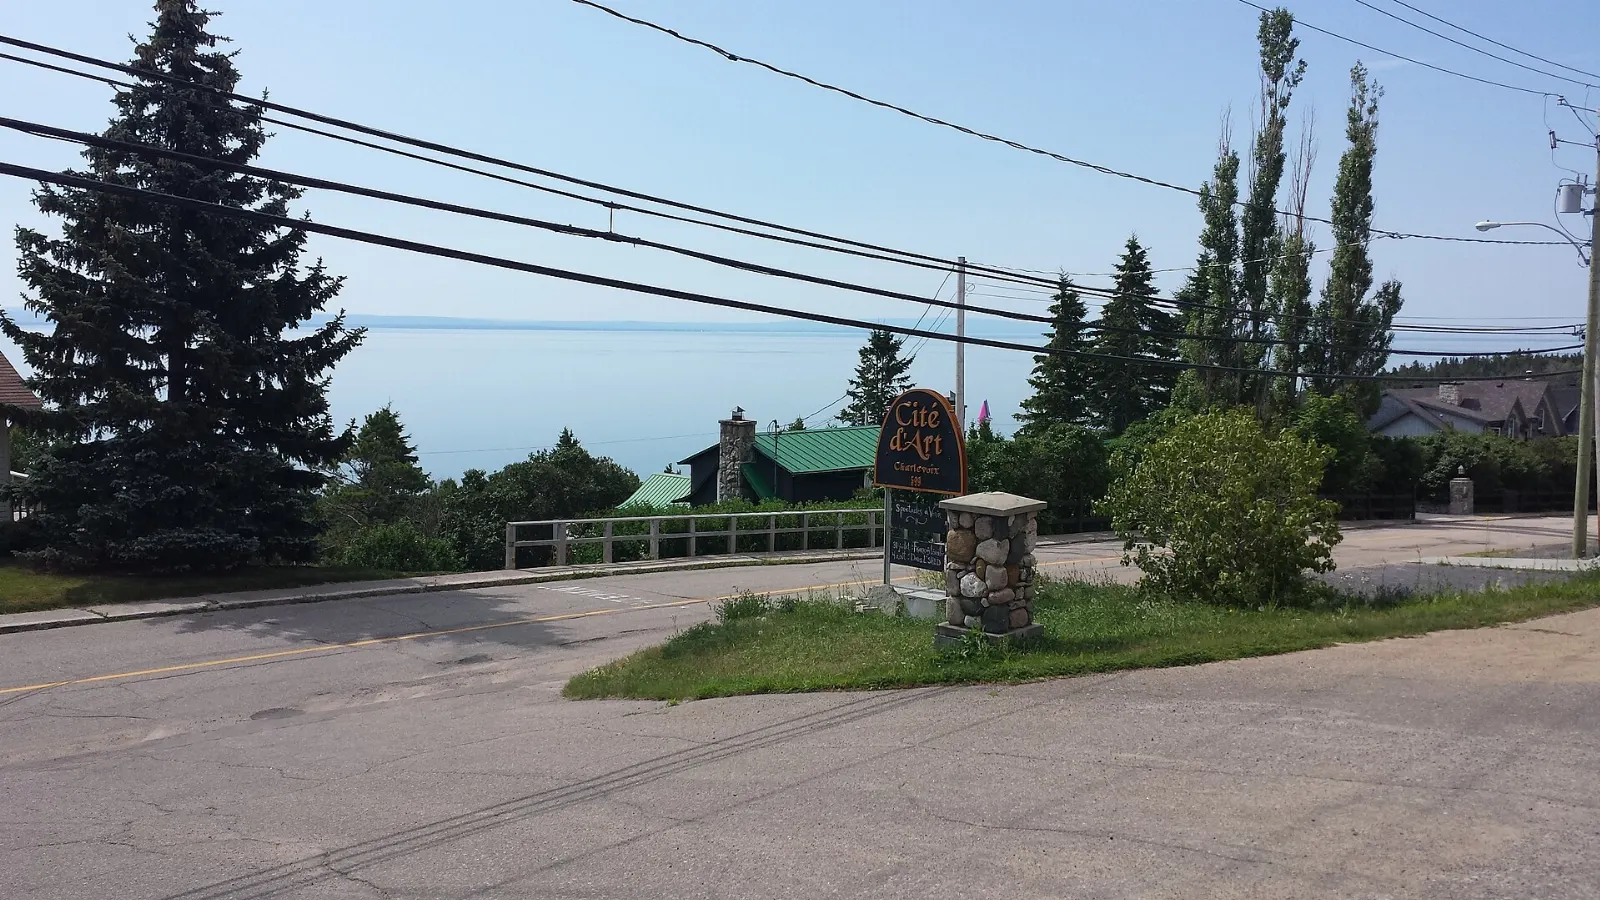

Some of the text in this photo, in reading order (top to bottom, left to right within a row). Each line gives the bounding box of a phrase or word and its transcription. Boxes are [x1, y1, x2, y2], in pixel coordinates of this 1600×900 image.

[896, 401, 940, 428] Cité
[890, 427, 942, 460] d'Art
[894, 462, 940, 474] Charlevoix
